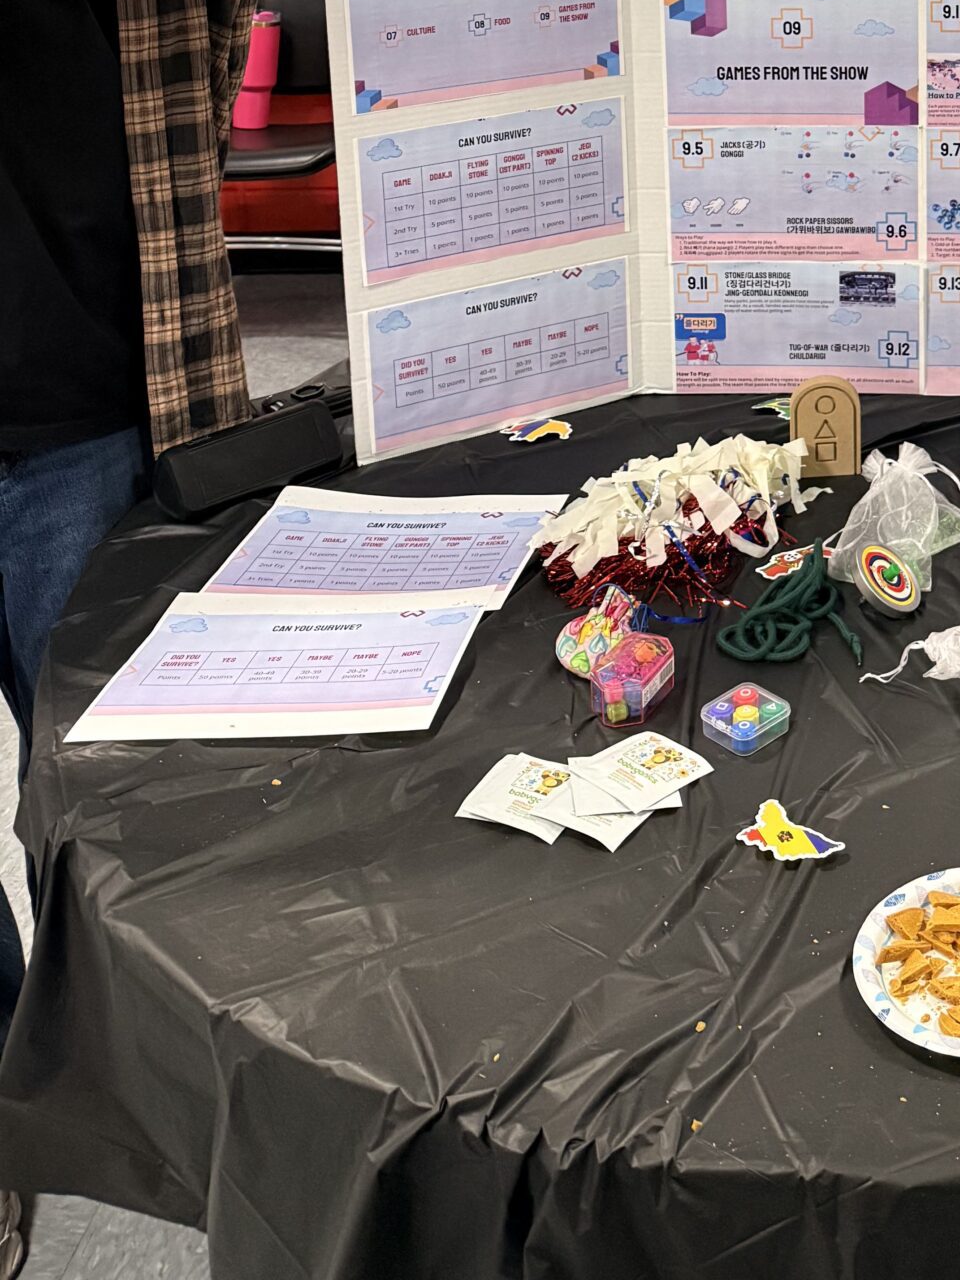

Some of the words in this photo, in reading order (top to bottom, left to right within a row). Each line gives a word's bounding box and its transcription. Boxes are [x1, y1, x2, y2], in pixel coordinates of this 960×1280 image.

[943, 5, 959, 18] 9.1
[475, 20, 484, 29] 08
[783, 22, 800, 35] 09
[387, 32, 397, 40] 07
[407, 26, 435, 36] CULTURE
[717, 67, 761, 81] GAMES
[764, 67, 800, 80] FROM
[804, 67, 827, 80] THE
[830, 67, 868, 81] SHOW
[459, 137, 474, 148] CAN
[476, 135, 492, 145] YOU
[494, 128, 531, 142] SURVIVE?
[682, 142, 703, 156] 9.5
[720, 141, 741, 149] JACKS
[940, 143, 960, 156] 9.7
[438, 196, 456, 206] points
[887, 225, 906, 238] 9.6
[688, 277, 708, 290] 9.11
[790, 344, 829, 352] TUG-OF-WAR
[886, 343, 910, 356] 9.12
[401, 360, 412, 369] DID
[413, 359, 425, 367] YOU
[398, 368, 428, 380] SURVIVE?
